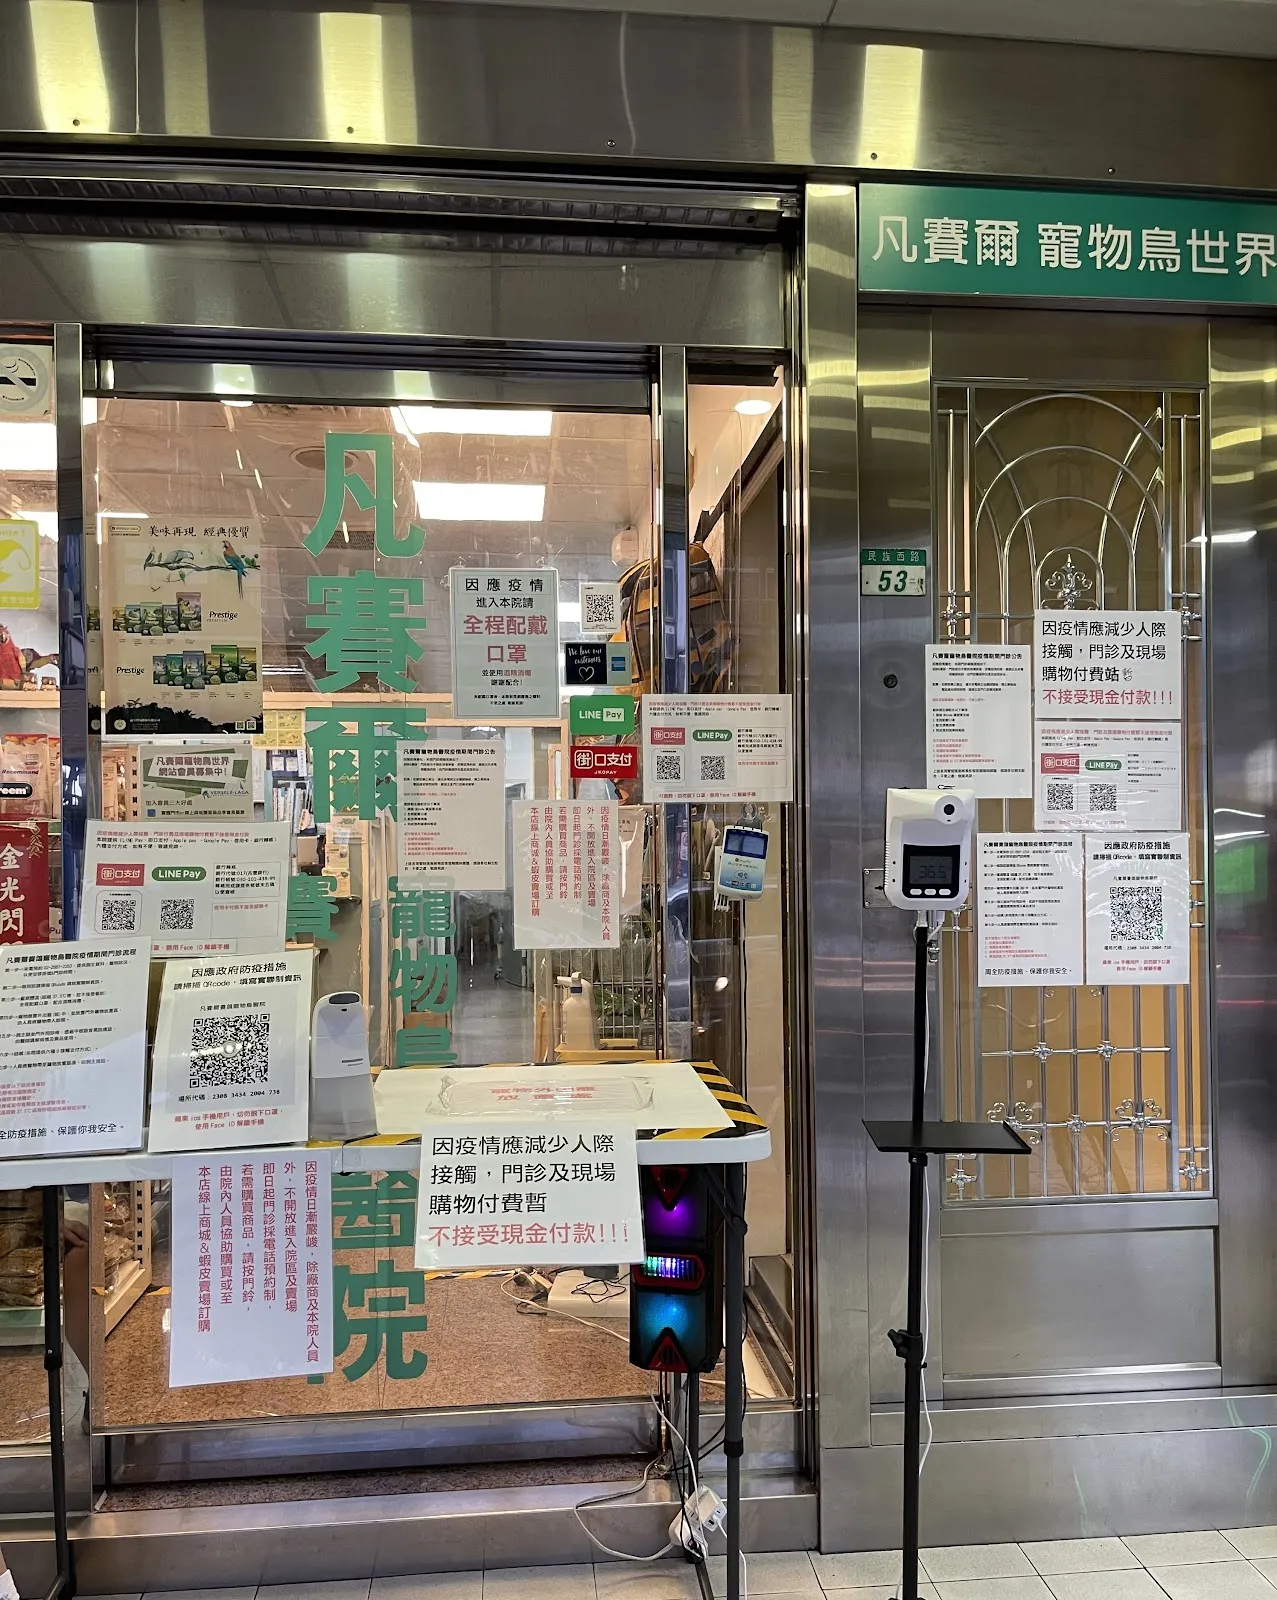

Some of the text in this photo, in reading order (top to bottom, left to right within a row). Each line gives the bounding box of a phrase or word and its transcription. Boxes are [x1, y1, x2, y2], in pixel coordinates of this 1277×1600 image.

[871, 214, 1277, 278] 凡賽爾 寵物鳥世界
[149, 525, 250, 539] 美味再現 經典優質
[868, 550, 920, 562] 民族西路
[465, 578, 543, 593] 因應疫情
[476, 597, 534, 609] 進入本院請
[209, 611, 239, 621] Prestige
[302, 431, 429, 823] 凡賽爾
[463, 615, 548, 636] 全程配戴
[1042, 620, 1166, 638] 因疫情應減少人際
[487, 644, 527, 664] 口罩
[1042, 643, 1166, 660] 接觸，門診及現場
[116, 666, 145, 676] Prestige
[1042, 667, 1119, 682] 購物付費站
[1042, 689, 1173, 705] 不接受現金付款!!!
[578, 710, 622, 720] LINE Pay
[697, 731, 728, 740] LINE Pay
[156, 756, 230, 766] 凡賽爾寵物鳥世界
[574, 749, 633, 769] 街口支付
[1089, 761, 1106, 769] LINE
[1104, 842, 1171, 850] 因應政府防疫措施
[102, 868, 140, 880] 街口支付
[158, 869, 201, 880] LINE Pay
[191, 962, 287, 978] 因應政府防疫措施
[173, 982, 201, 990] 請掃描
[210, 1121, 225, 1129] Face
[432, 1134, 615, 1156] 因疫情應減少人際
[430, 1161, 617, 1185] 接觸，門診及現場
[428, 1192, 548, 1215] 購物付費暫
[220, 1165, 233, 1305] 由院內人員協助購買或至
[283, 1161, 298, 1313] 外，不開放進入院區及賣場
[428, 1221, 629, 1247] 不接受現金付款!!!
[197, 1165, 211, 1333] 本店線上商城&蝦皮賣場訂購
[305, 1160, 319, 1363] 因疫情日漸嚴峻，除廠商及本院人員
